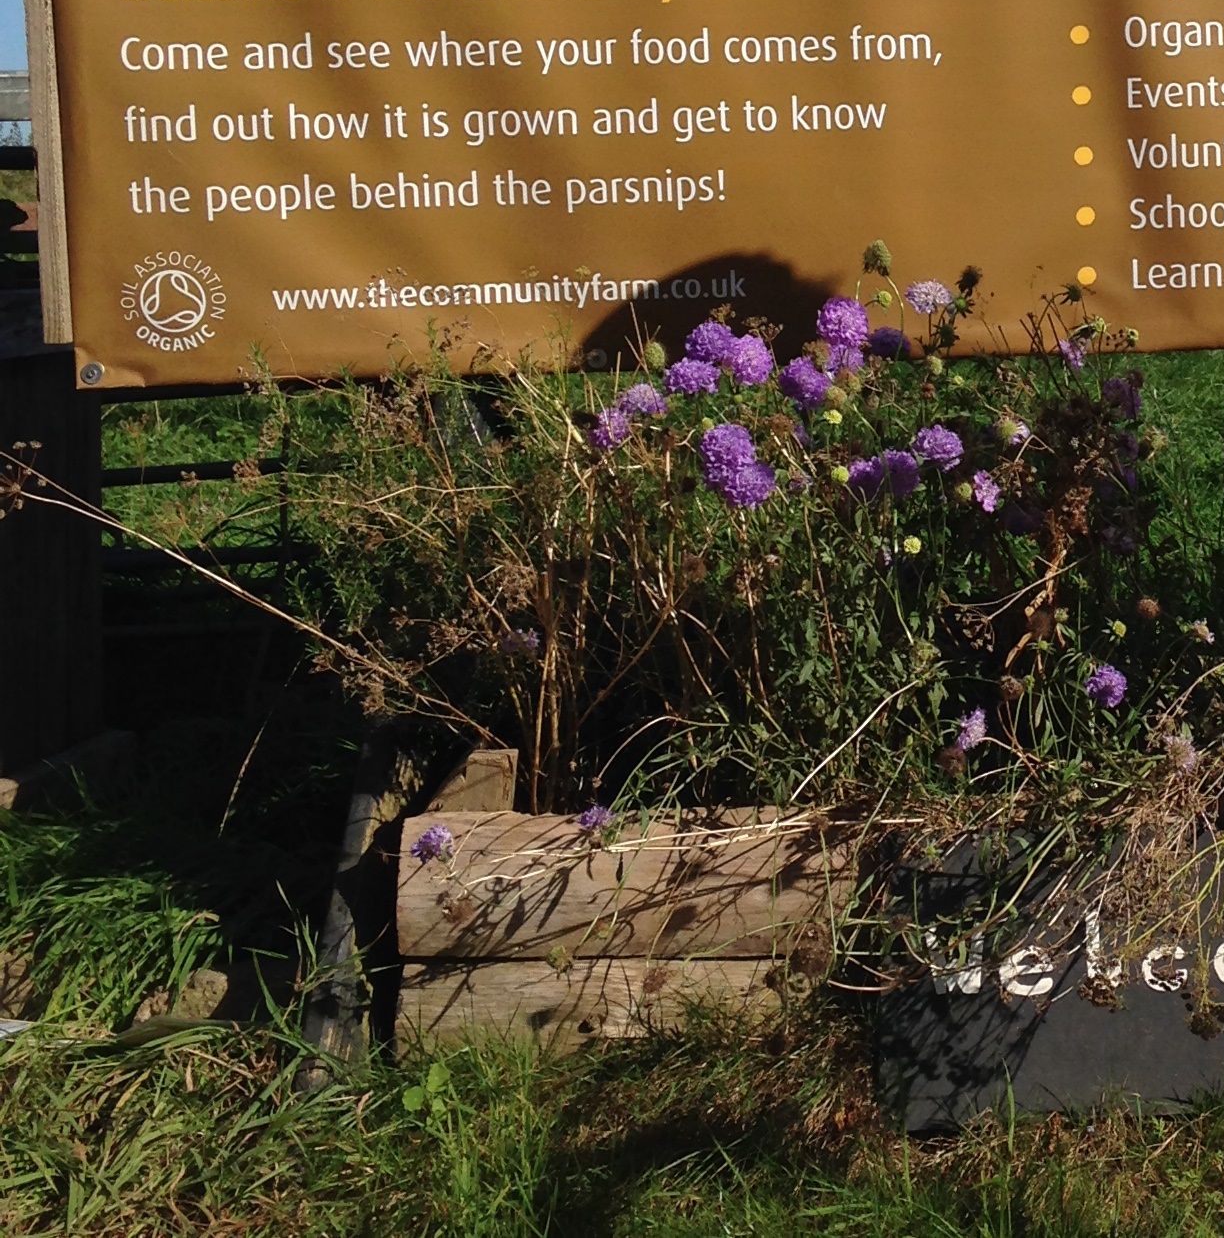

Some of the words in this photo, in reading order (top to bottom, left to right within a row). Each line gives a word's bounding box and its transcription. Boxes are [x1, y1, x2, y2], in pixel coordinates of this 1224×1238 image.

[120, 36, 229, 71] Come
[243, 31, 313, 70] and
[327, 41, 391, 69] see
[404, 30, 523, 67] where
[536, 38, 617, 75] your
[630, 27, 711, 65] food
[723, 34, 837, 64] comes
[849, 24, 943, 66] from,
[124, 104, 198, 142] find
[211, 106, 275, 142] out
[288, 103, 370, 140] how
[384, 103, 408, 139] it
[422, 102, 450, 138] is
[463, 108, 579, 147] grown
[592, 97, 659, 136] and
[672, 99, 731, 144] get
[742, 99, 778, 132] to
[791, 95, 887, 131] know
[128, 175, 191, 214] the
[206, 172, 336, 222] people
[350, 169, 480, 210] behind
[491, 168, 552, 207] the
[565, 167, 727, 214] parsnips!
[120, 281, 140, 322] SOIL
[133, 250, 228, 321] ASSOCIATION
[135, 323, 216, 353] ORGANIC
